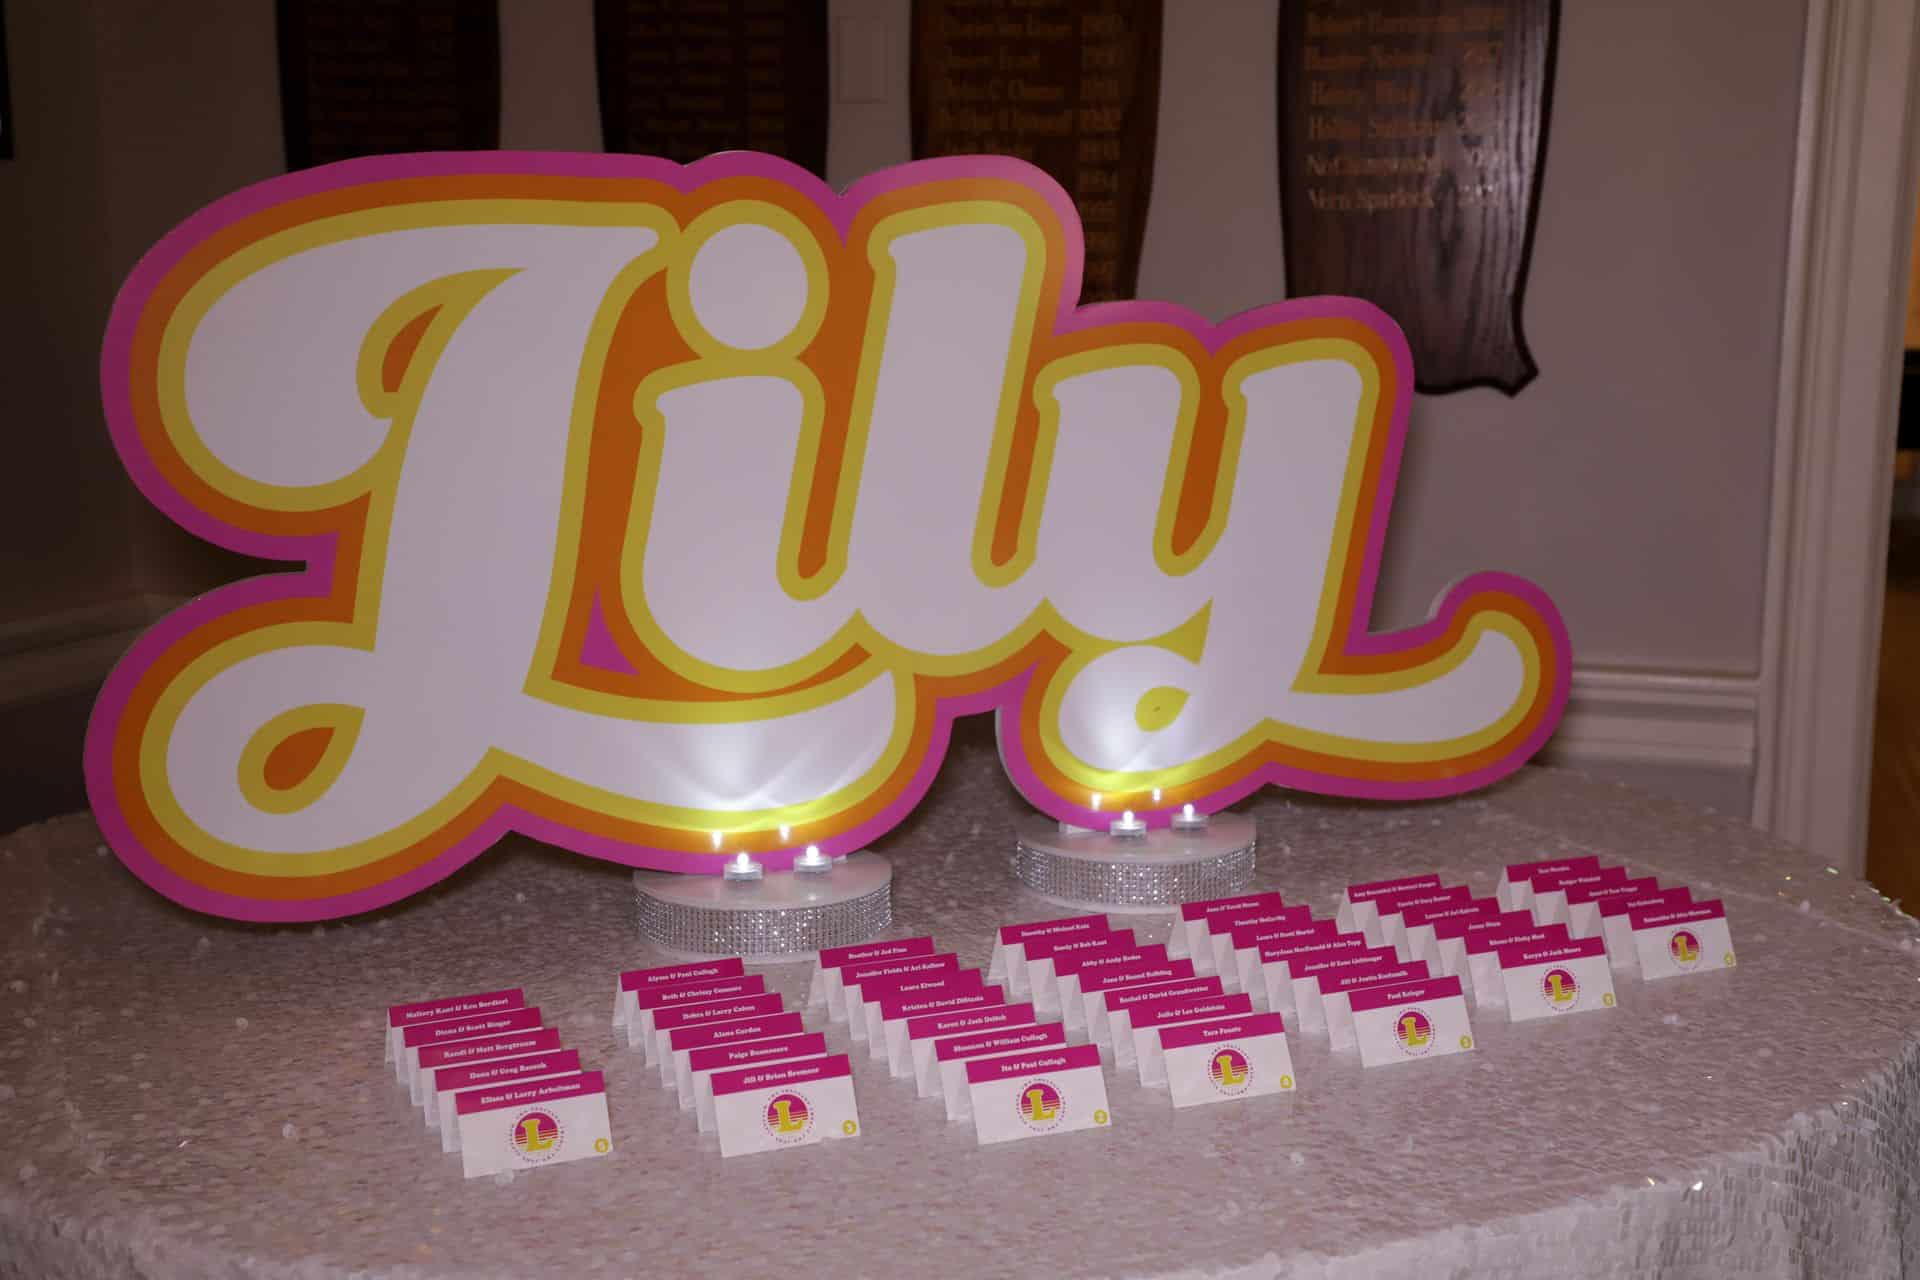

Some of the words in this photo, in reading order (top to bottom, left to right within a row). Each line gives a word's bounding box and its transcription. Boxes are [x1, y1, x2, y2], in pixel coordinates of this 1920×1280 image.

[125, 180, 1548, 890] Lily
[1674, 936, 1697, 962] L
[1548, 975, 1574, 1002] L
[1401, 1017, 1428, 1046] L
[1216, 1055, 1246, 1086] L
[773, 1100, 803, 1133] L
[1026, 1089, 1057, 1121] L
[520, 1118, 553, 1152] L
